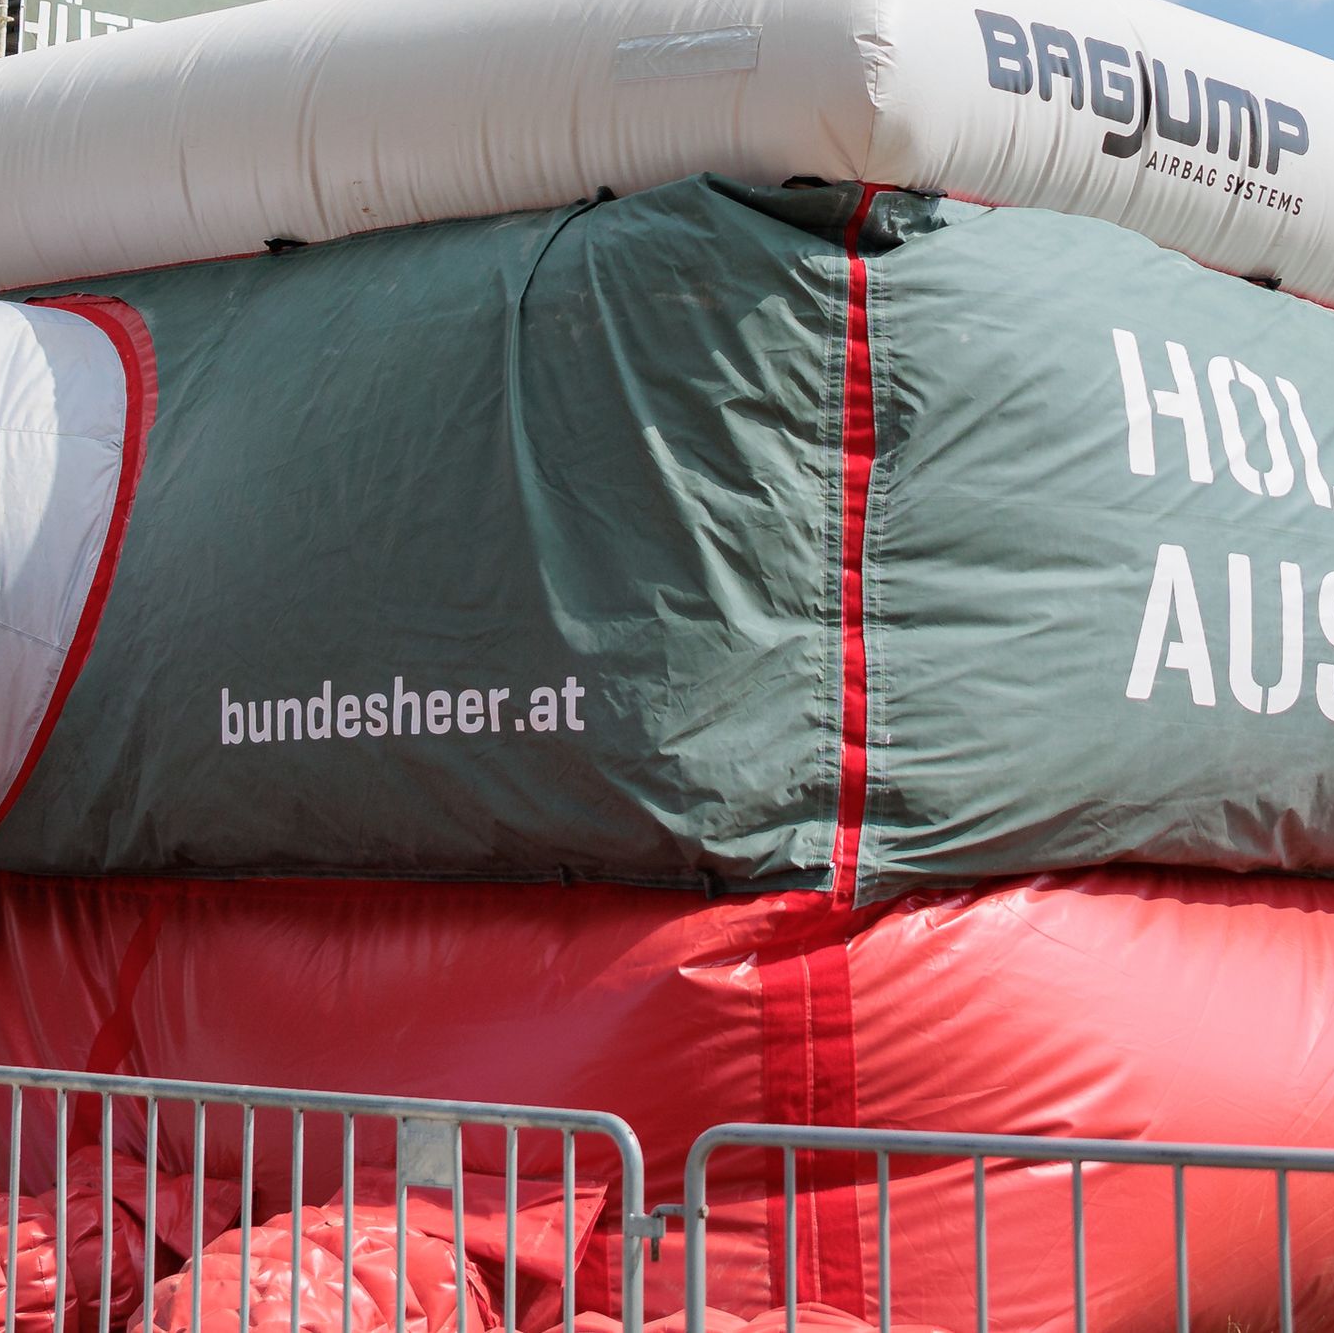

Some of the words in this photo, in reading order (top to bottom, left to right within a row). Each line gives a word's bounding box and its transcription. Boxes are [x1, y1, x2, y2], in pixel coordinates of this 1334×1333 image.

[974, 9, 1309, 175] BAGJUMP
[1145, 150, 1217, 187] AIRBAG
[1223, 173, 1304, 216] SYSTEMS
[221, 676, 585, 745] bundesheer.at
